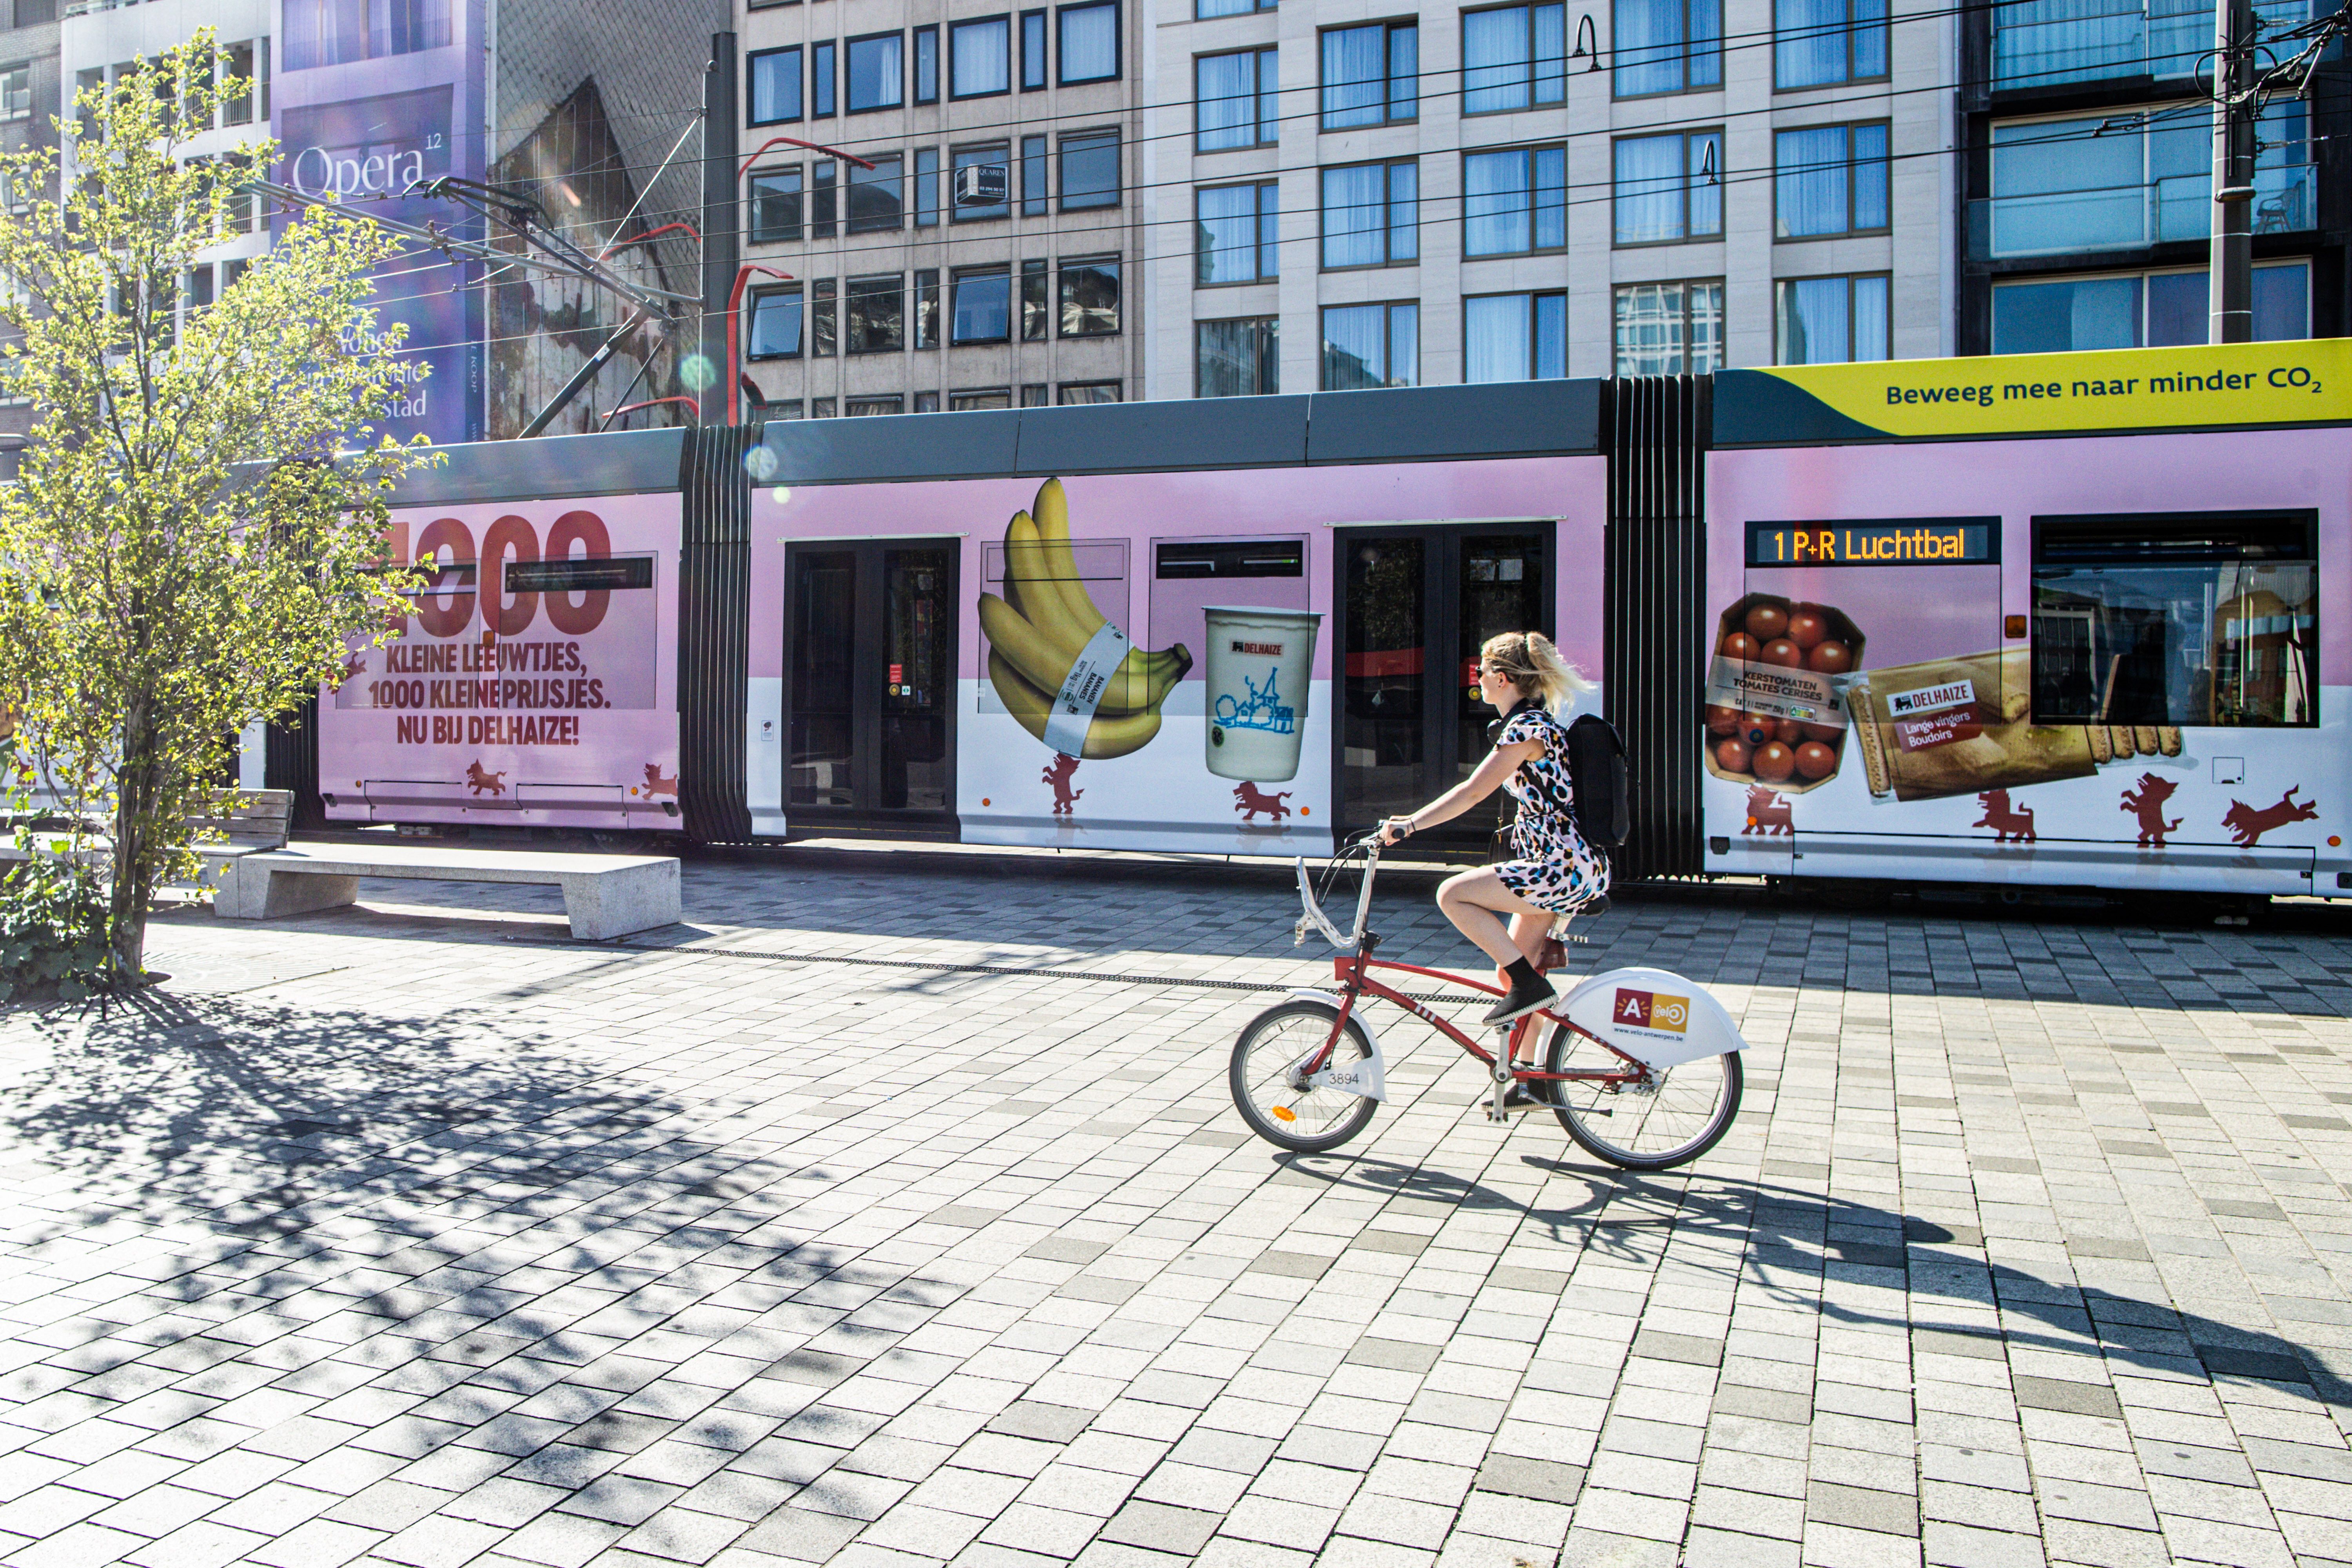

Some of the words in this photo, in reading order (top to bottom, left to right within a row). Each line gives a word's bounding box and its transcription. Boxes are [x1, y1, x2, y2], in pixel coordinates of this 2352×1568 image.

[292, 147, 423, 204] Opera
[426, 133, 442, 150] 12
[1887, 385, 1994, 407] Beweeg
[2004, 382, 2062, 399] mee
[2072, 378, 2139, 397] naar
[2150, 369, 2257, 393] minder
[1775, 532, 1783, 560] 1
[1794, 531, 1835, 560] P+R
[1846, 528, 1964, 559] Luchtbal
[367, 510, 611, 638] 1000
[386, 644, 457, 673] KLEINE
[463, 642, 587, 677] LEEUWTJES,
[1244, 643, 1282, 655] DELHAIZE
[1079, 672, 1097, 700] BANANES
[1087, 675, 1104, 704] BANANEN
[1733, 678, 1779, 693] TOMATES
[1782, 686, 1822, 701] CERISES
[1744, 671, 1818, 691] KERSTOMATEN
[368, 680, 425, 709] 1000
[430, 679, 499, 709] KLEINE
[502, 679, 611, 709] PRIJSJES.
[1912, 685, 1969, 708] DELHAIZE
[397, 716, 428, 744] NU
[433, 716, 463, 744] BIJ
[468, 716, 579, 746] DELHAIZE!
[1905, 720, 1934, 735] Lange
[1935, 712, 1971, 728] vingers
[1908, 730, 1953, 747] Boudoirs
[1623, 998, 1642, 1018] A
[1614, 1027, 1683, 1042] www.velo-antwerpen.be
[1329, 1073, 1359, 1084] 3894
